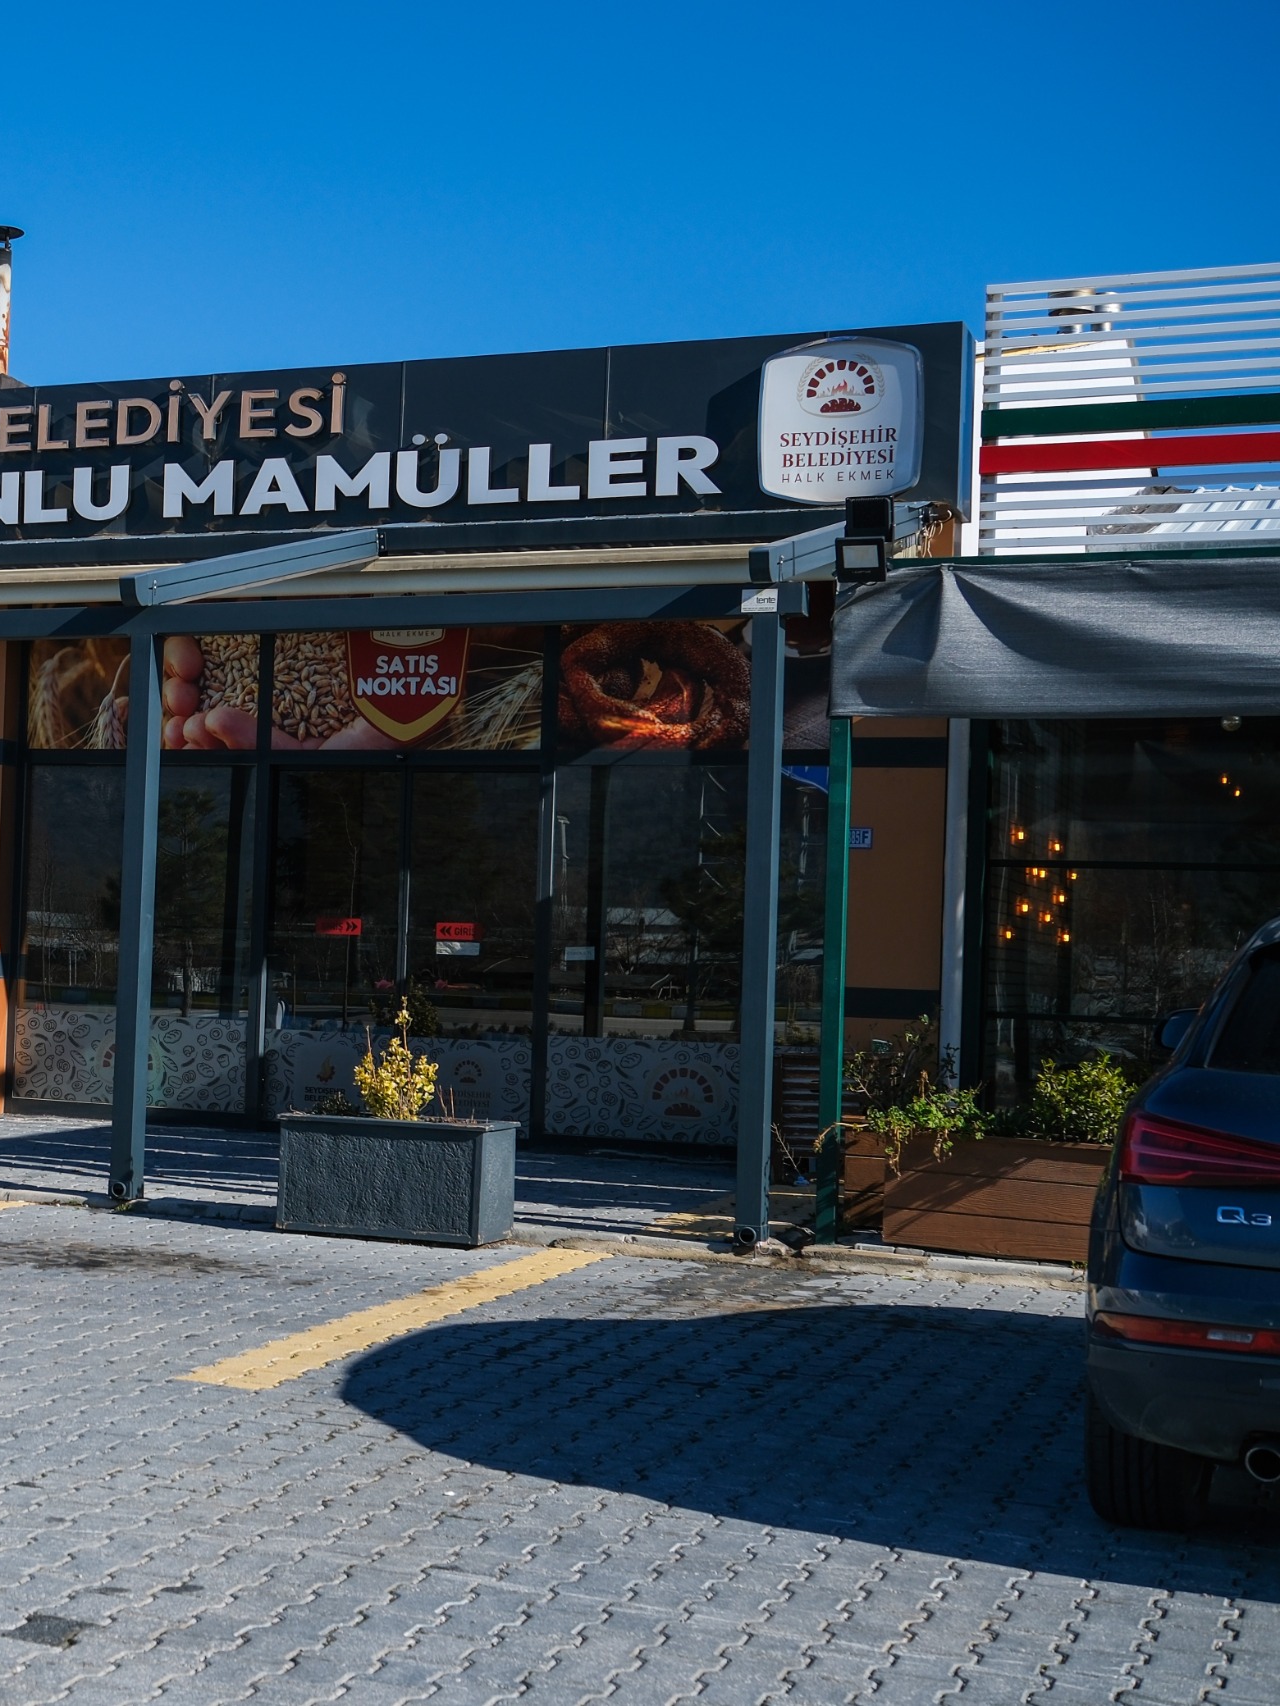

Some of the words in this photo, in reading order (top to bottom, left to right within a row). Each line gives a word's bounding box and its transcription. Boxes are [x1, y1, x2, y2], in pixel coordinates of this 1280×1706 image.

[780, 425, 898, 448] SEYDİŞEHİR
[782, 445, 895, 468] BELEDİYESİ
[163, 434, 722, 518] MAMÜLLER
[781, 472, 825, 483] HALK
[837, 469, 894, 482] EKMEK
[756, 596, 776, 604] tente
[380, 630, 401, 638] HALK
[375, 654, 439, 675] SATIŞ
[356, 676, 457, 696] NOKTASI
[1216, 1206, 1272, 1226] Q3
